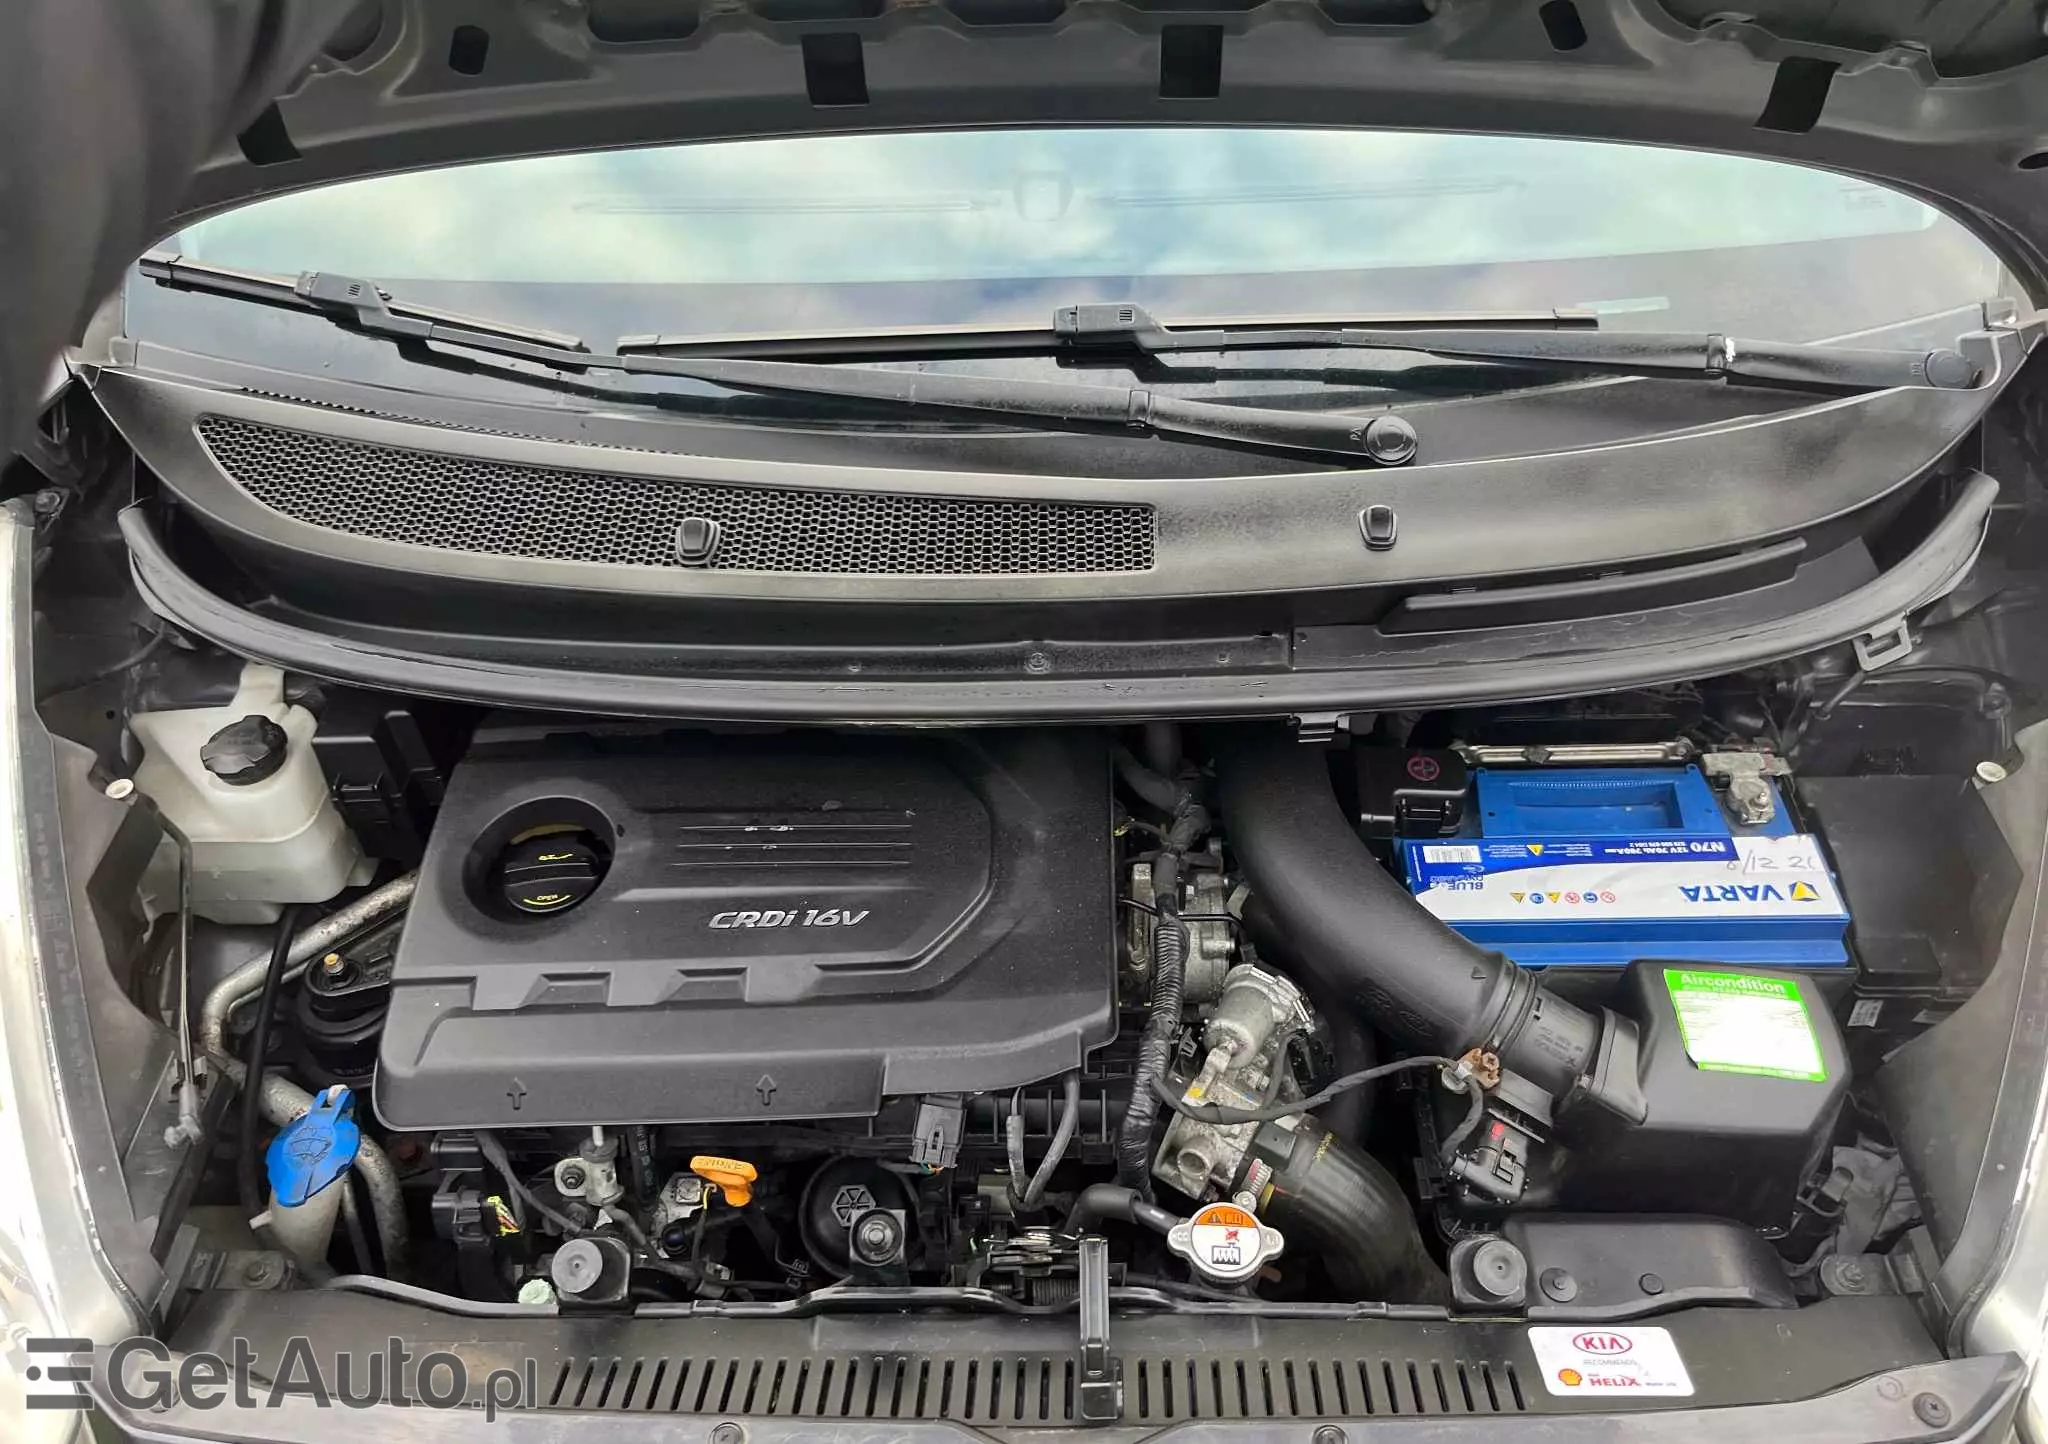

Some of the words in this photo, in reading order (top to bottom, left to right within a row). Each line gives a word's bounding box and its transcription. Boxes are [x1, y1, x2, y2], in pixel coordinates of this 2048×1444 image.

[1690, 841, 1726, 853] N70
[1447, 881, 1484, 890] BLUE
[1679, 885, 1785, 902] VARTA
[708, 909, 798, 929] CRDi
[802, 908, 871, 927] 16V
[1680, 973, 1786, 994] Aircondition
[1582, 1336, 1625, 1351] KIA
[1589, 1375, 1642, 1387] HELIX
